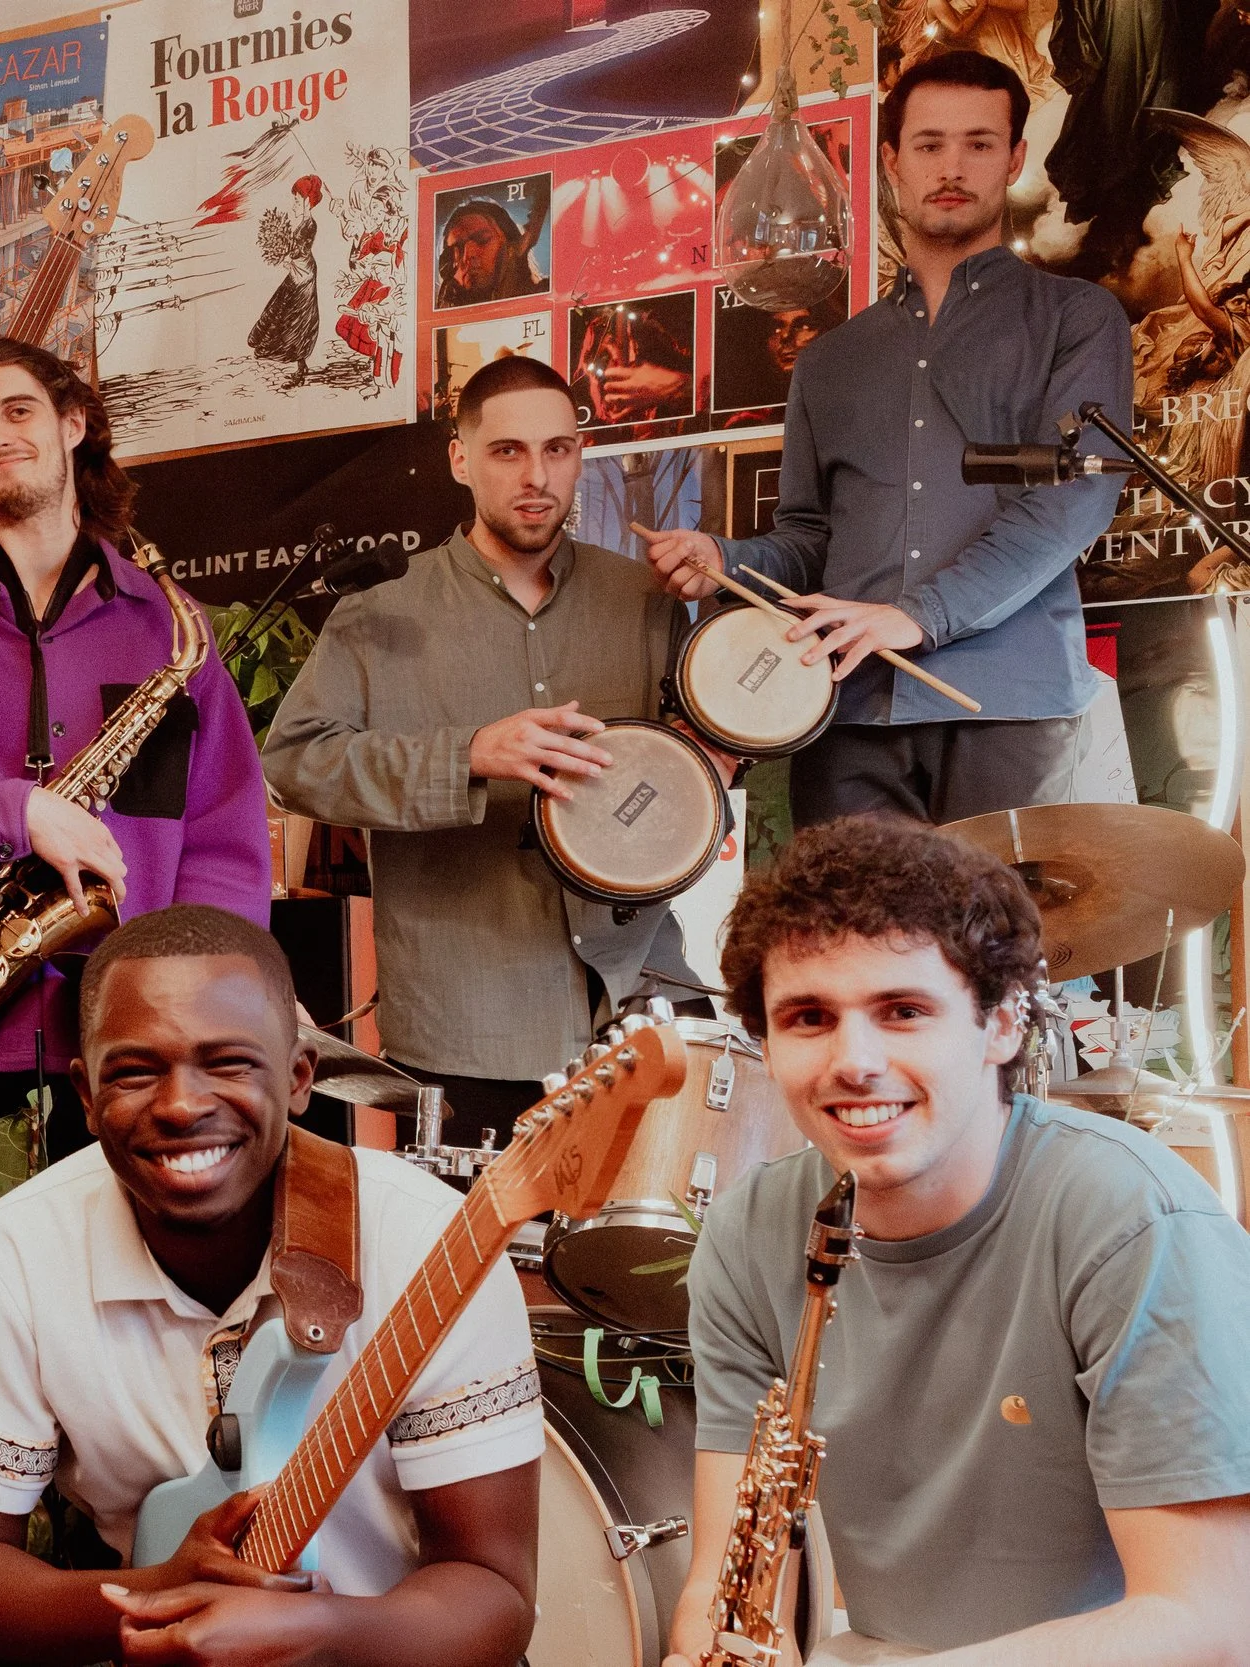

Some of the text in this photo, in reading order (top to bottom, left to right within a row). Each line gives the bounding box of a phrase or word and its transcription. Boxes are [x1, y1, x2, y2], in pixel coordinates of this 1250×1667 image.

[150, 10, 353, 88] Fourmies
[29, 82, 49, 92] Simon
[155, 68, 348, 139] la Rouge
[507, 182, 526, 202] PI
[691, 245, 707, 265] N
[522, 319, 545, 339] FL
[1158, 387, 1250, 427] BRE
[171, 551, 249, 580] CLINT
